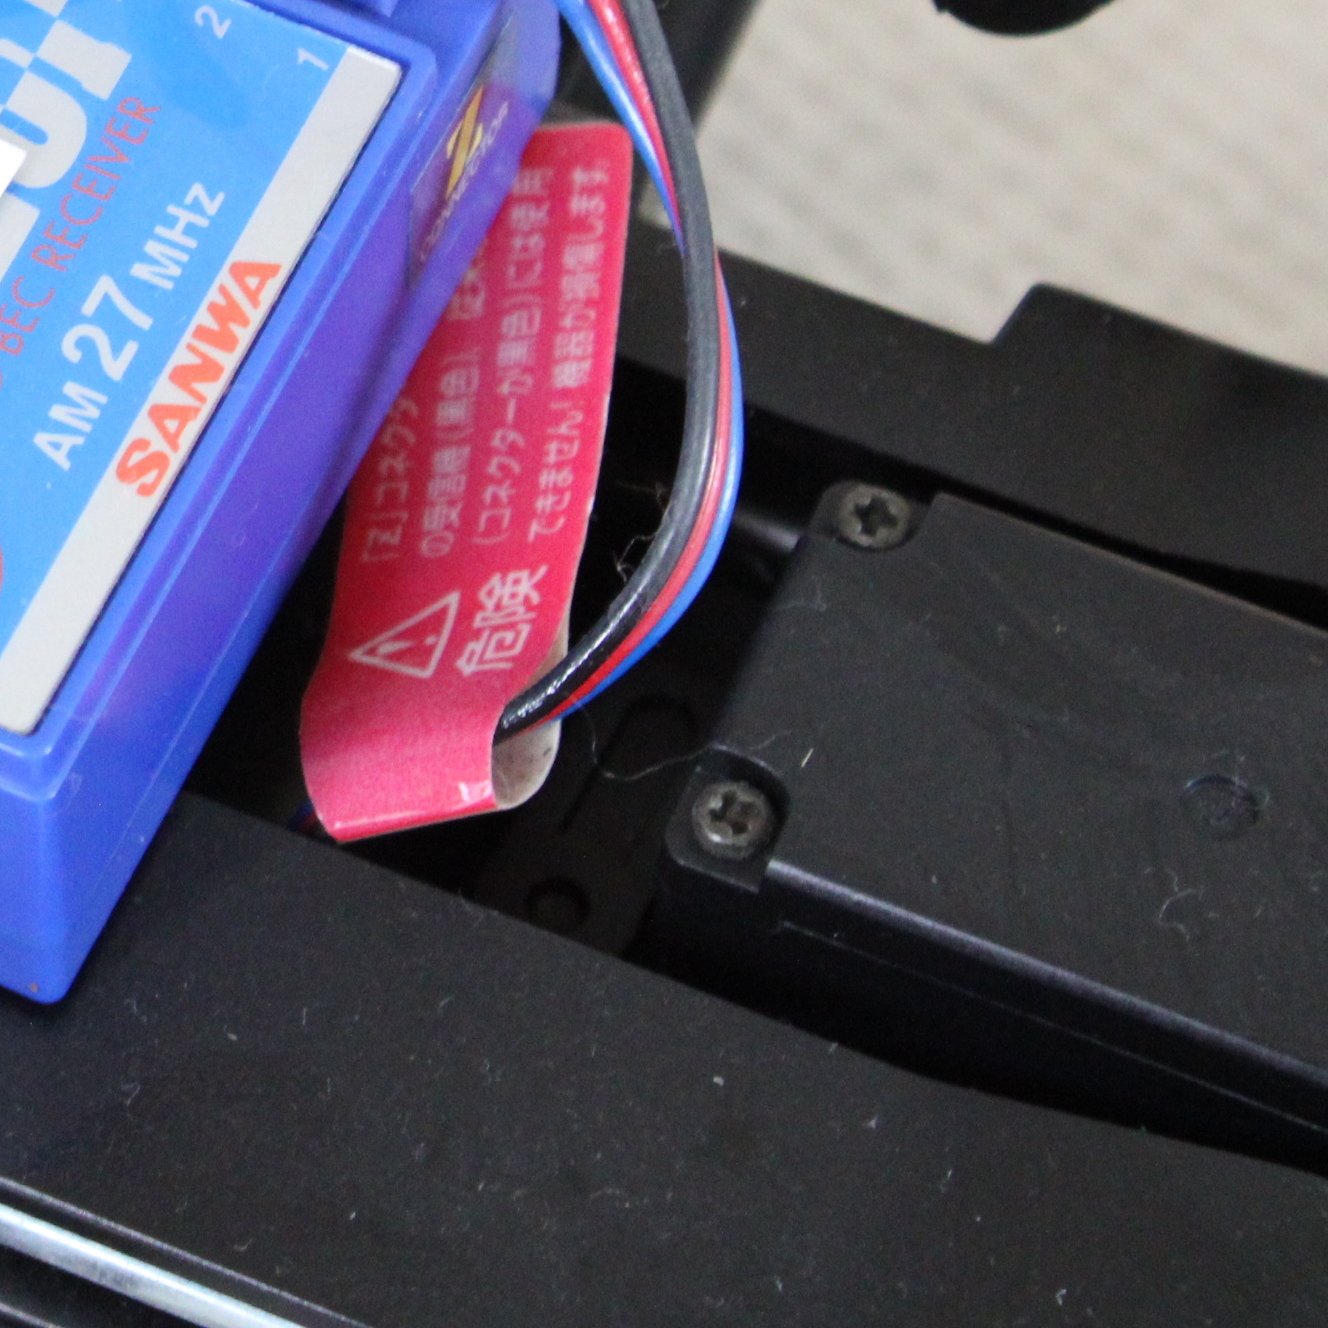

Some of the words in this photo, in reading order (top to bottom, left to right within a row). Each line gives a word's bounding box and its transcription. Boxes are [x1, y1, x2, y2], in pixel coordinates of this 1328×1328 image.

[193, 4, 235, 41] 2
[296, 46, 330, 74] 1
[31, 94, 160, 273] RECEIVER
[128, 182, 225, 291] MHz
[61, 276, 155, 383] 27
[114, 259, 282, 497] SANWA
[32, 381, 107, 472] AM
[456, 563, 547, 676] 危険
